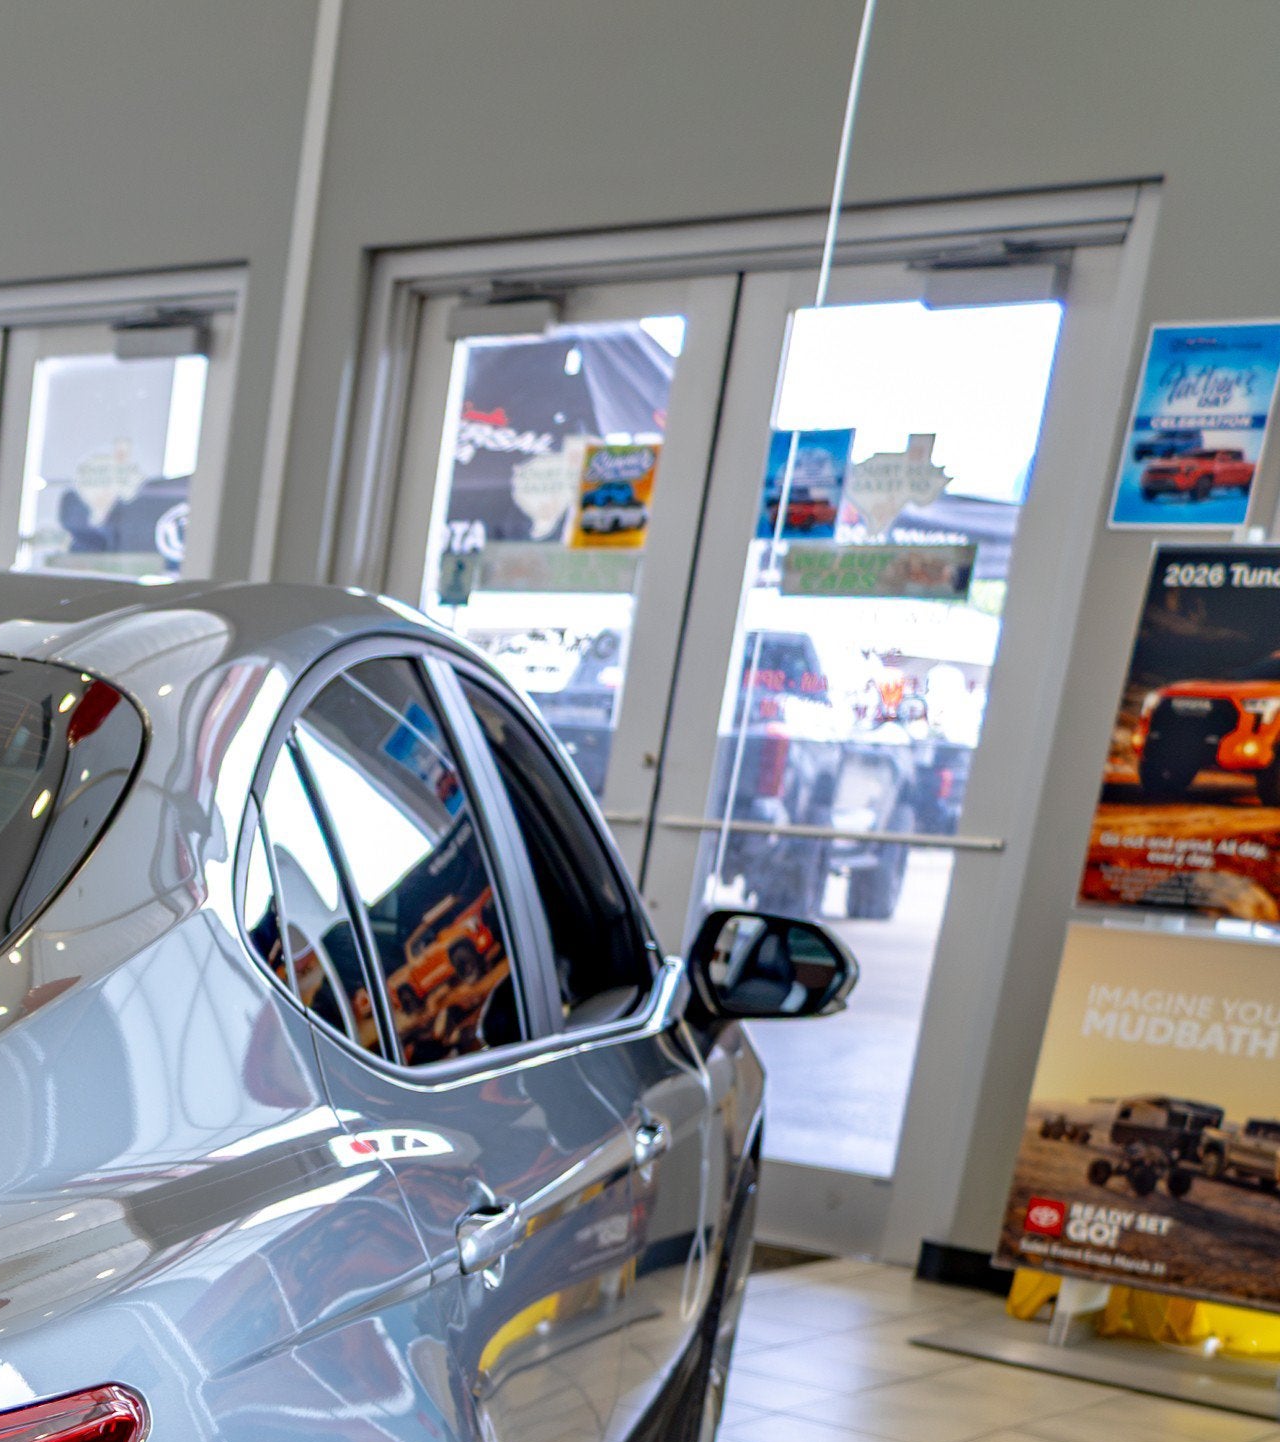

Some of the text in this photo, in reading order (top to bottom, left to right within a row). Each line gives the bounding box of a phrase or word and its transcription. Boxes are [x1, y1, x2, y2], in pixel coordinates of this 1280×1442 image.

[1150, 415, 1251, 429] CELEBRATION
[1163, 562, 1226, 588] 2026
[1088, 981, 1214, 1019] IMAGINE
[1082, 1008, 1280, 1060] MUDBATH
[1066, 1218, 1120, 1248] GO!
[1070, 1202, 1173, 1237] READY SET
